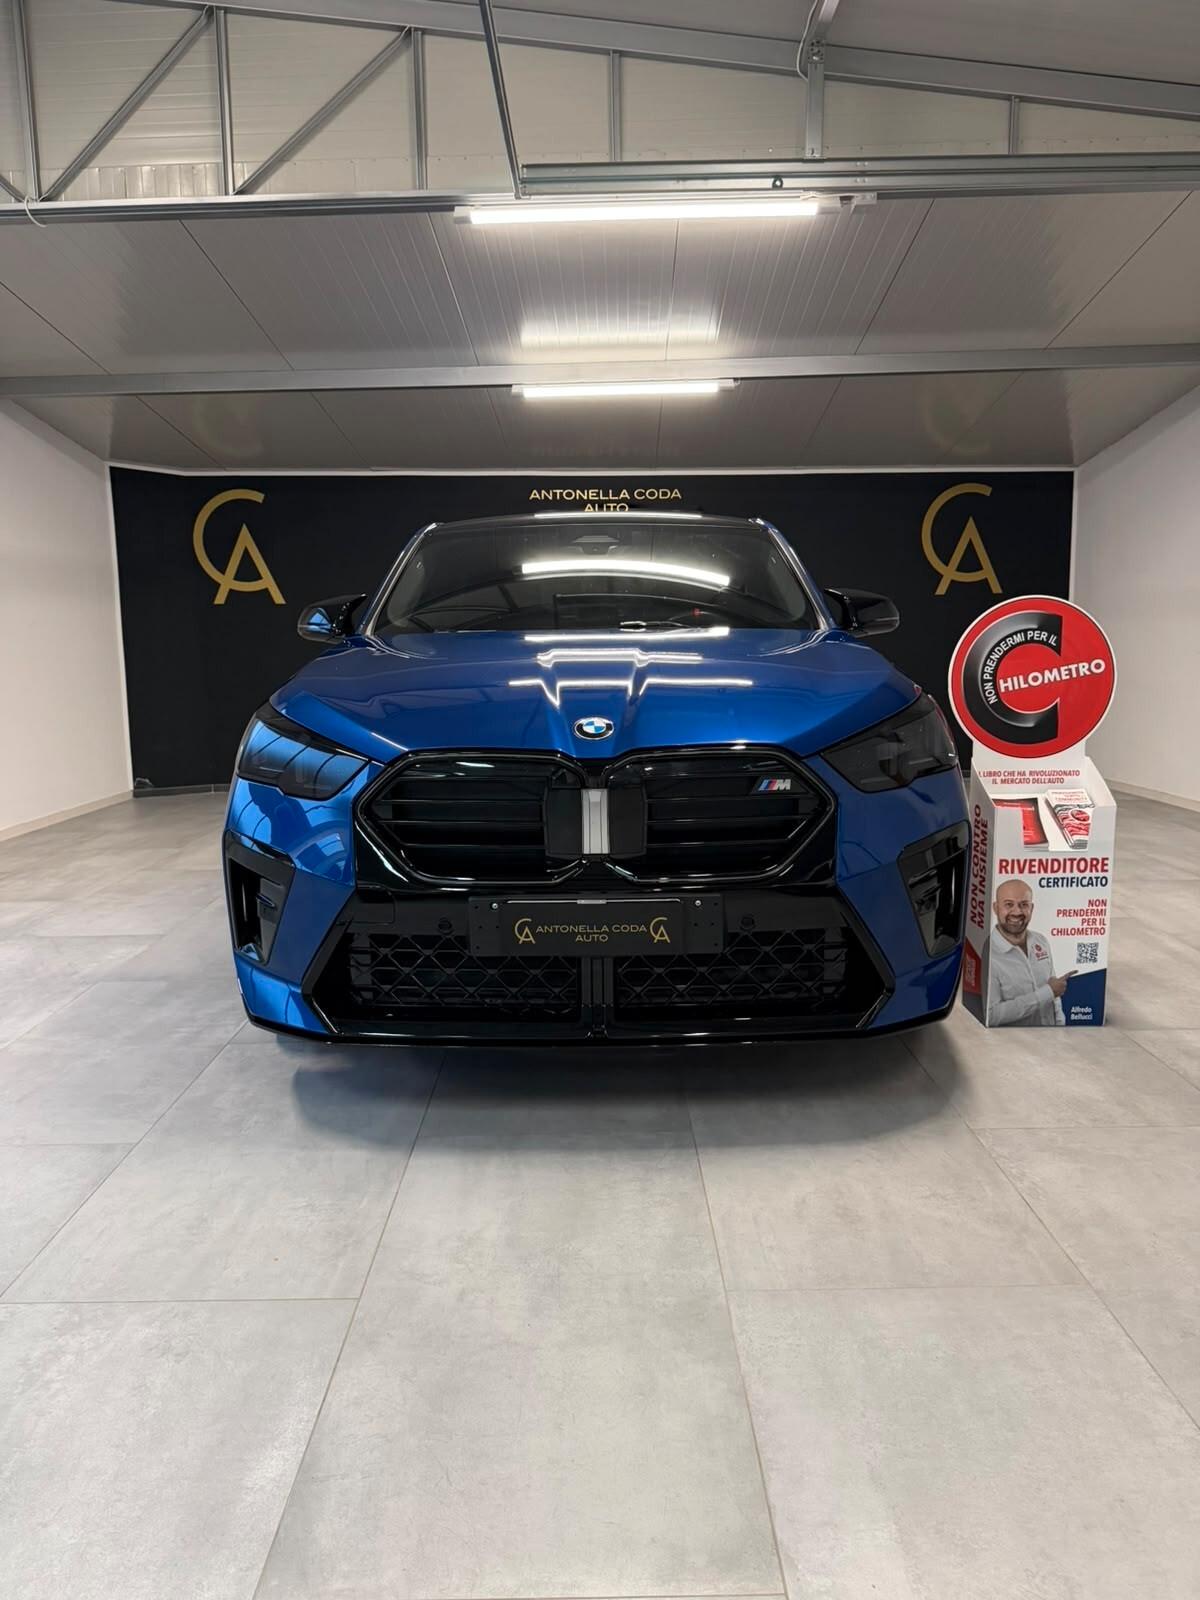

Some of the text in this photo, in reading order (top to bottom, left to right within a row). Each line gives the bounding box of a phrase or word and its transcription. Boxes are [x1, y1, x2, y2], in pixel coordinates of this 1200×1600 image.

[529, 488, 682, 500] ANTONELLA CODA
[983, 630, 1058, 705] NON PRENDERMI PER IL
[983, 770, 1002, 778] LIBRO
[1028, 769, 1081, 777] RIVOLUZIONATO
[1032, 777, 1065, 785] DELL'AUTO
[970, 804, 981, 924] NON CONTRO
[998, 857, 1110, 875] RIVENDITORE
[977, 818, 988, 929] MA INSIEME
[1038, 876, 1108, 889] CERTIFICATO
[1087, 899, 1108, 908] NON
[1056, 908, 1107, 918] PRENDERMI
[1081, 918, 1107, 926] PER IL
[535, 924, 610, 934] ANTONELLA
[611, 923, 648, 933] CODA
[1050, 927, 1106, 937] CHILOMETRO
[575, 934, 609, 943] AUTO
[1070, 1006, 1093, 1014] Alfredo
[1070, 1013, 1093, 1021] Bellucci
